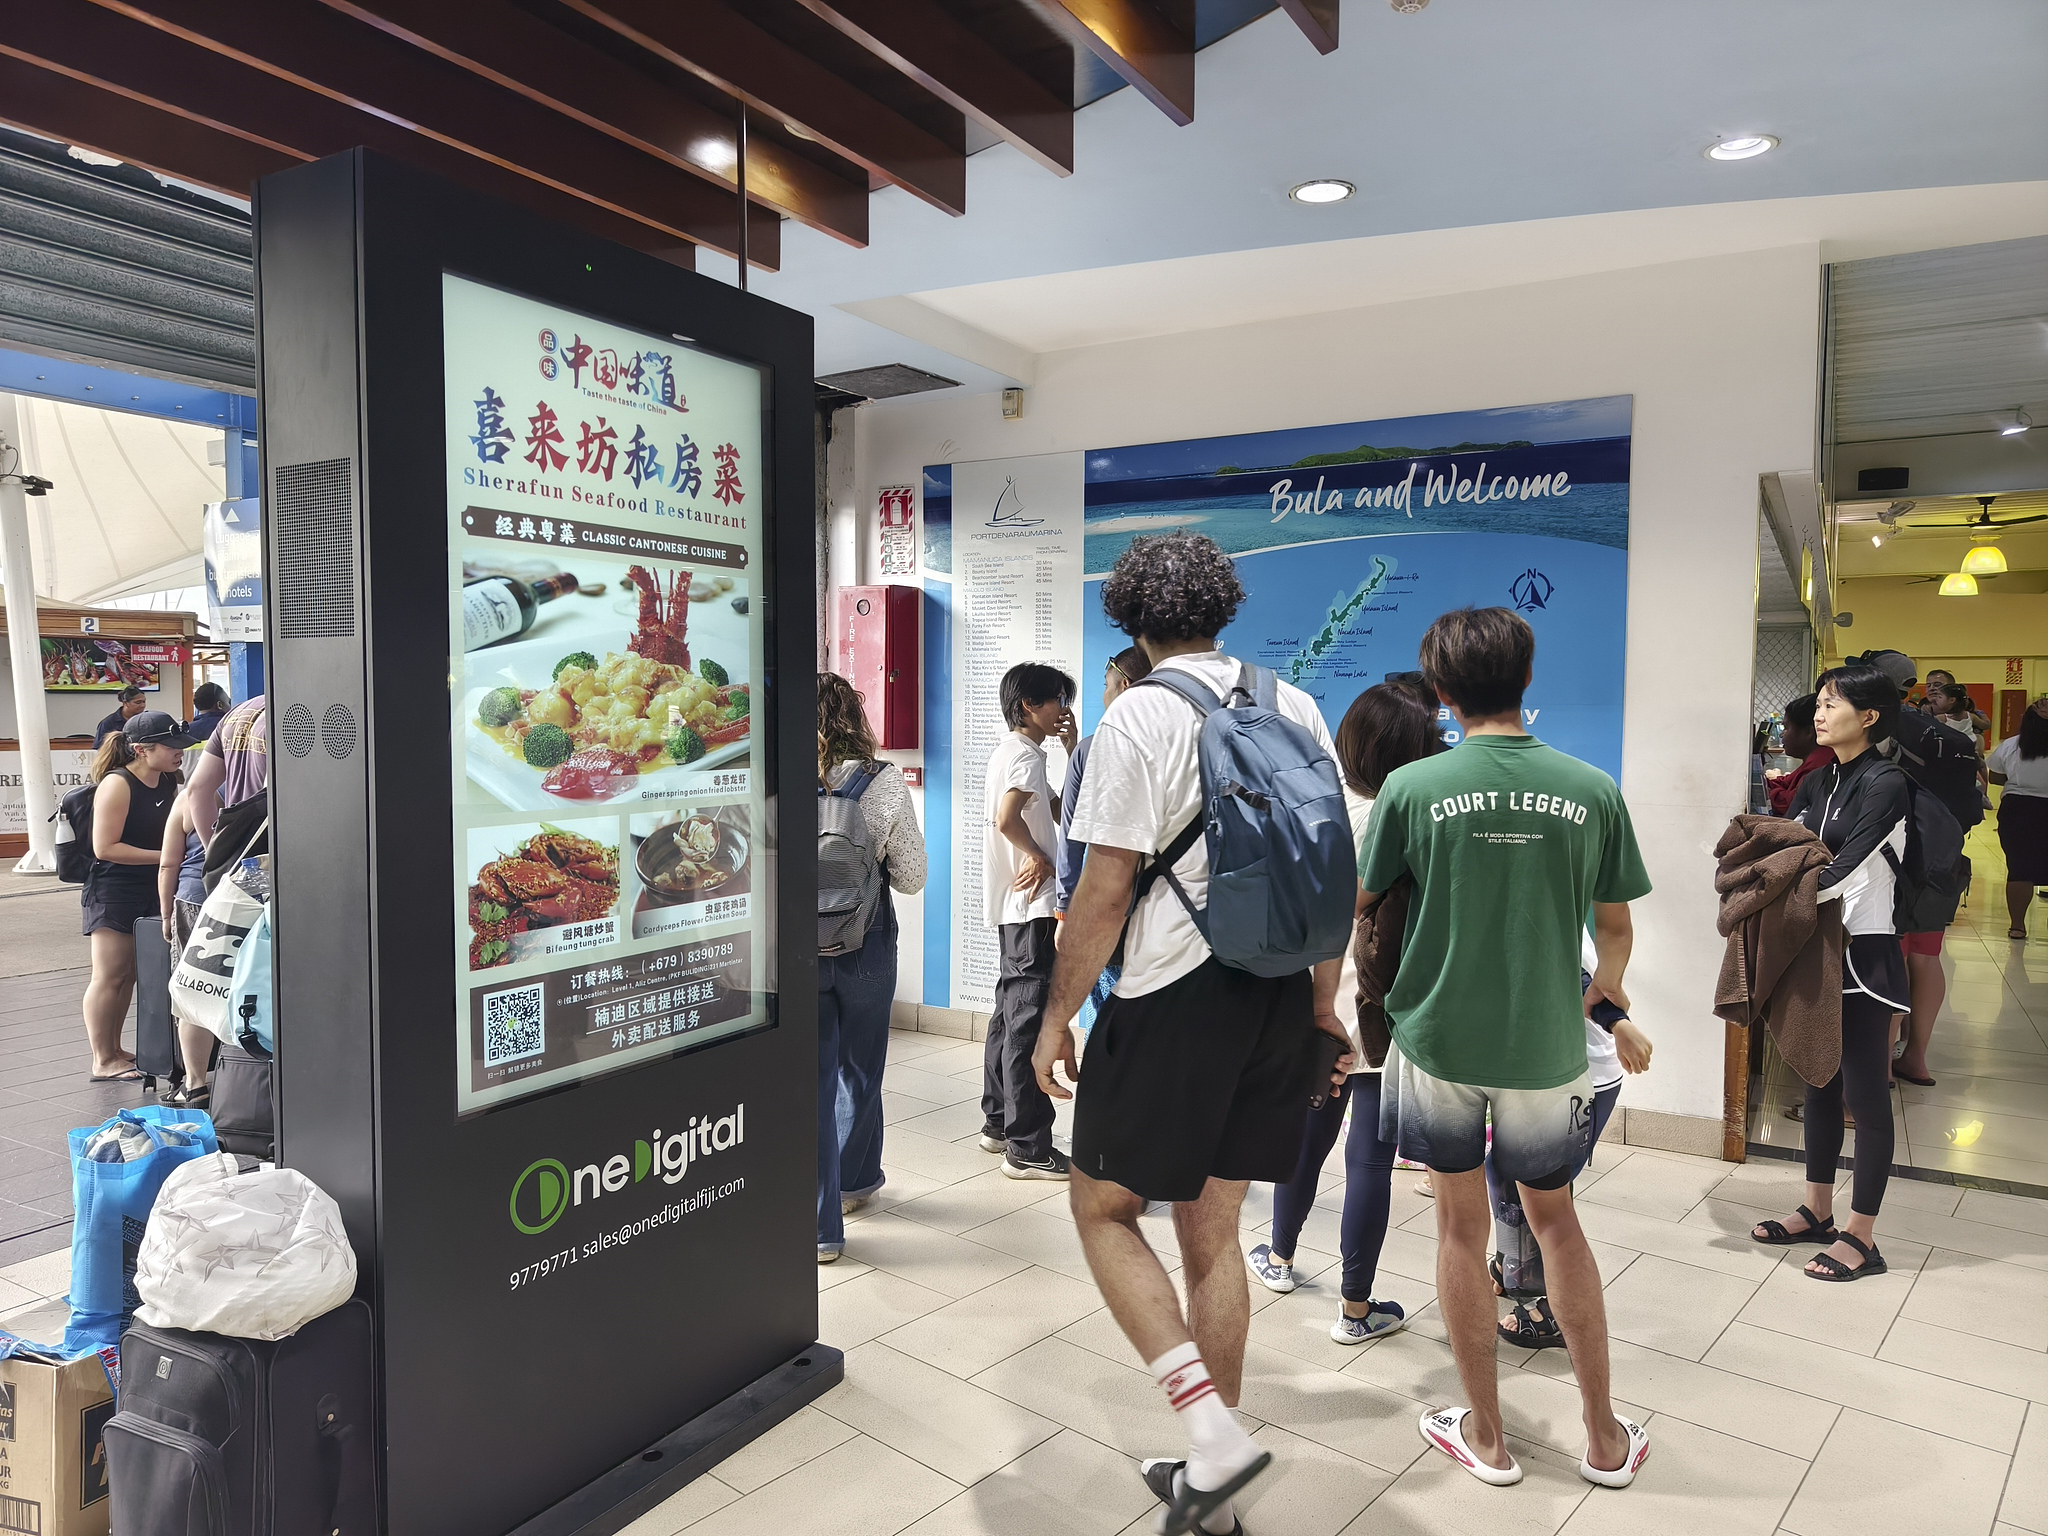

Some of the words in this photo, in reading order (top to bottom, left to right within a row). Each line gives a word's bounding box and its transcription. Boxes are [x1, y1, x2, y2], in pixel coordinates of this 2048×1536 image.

[582, 387, 603, 400] Taste
[604, 393, 617, 403] the
[618, 395, 637, 408] taste
[638, 402, 646, 410] of
[647, 404, 667, 416] China
[468, 386, 745, 507] 喜来坊私房菜
[463, 467, 564, 500] Sherafun
[571, 485, 648, 514] Seafood
[655, 500, 747, 530] Restaurant
[1269, 475, 1343, 524] Bula
[1354, 463, 1414, 518] and
[1424, 461, 1572, 508] Welcome
[495, 514, 577, 545] 经典粤菜
[581, 530, 626, 546] CLASSIC
[628, 537, 689, 555] CANTONESE
[690, 545, 727, 560] CUISINE
[1526, 567, 1537, 579] N
[1381, 603, 1399, 612] Island
[85, 618, 95, 632] 2
[1356, 627, 1373, 636] Island
[1283, 637, 1300, 646] Island
[642, 791, 666, 799] Ginger
[1430, 791, 1498, 822] COURT
[1510, 791, 1587, 825] LEGEND
[562, 921, 614, 941] 避风塘炒蟹
[643, 922, 680, 934] Cordyceps
[681, 918, 703, 928] Flower
[704, 912, 731, 923] Chicken
[731, 909, 747, 919] Soup
[598, 935, 615, 944] crab
[687, 942, 733, 963] 8390789
[611, 984, 628, 993] Level
[594, 982, 714, 1028] 楠迪区域提供接送
[611, 1010, 701, 1049] 外卖配送服务
[509, 1247, 578, 1291] 9779771
[582, 1176, 745, 1259] sales@onedigitalfiji.com
